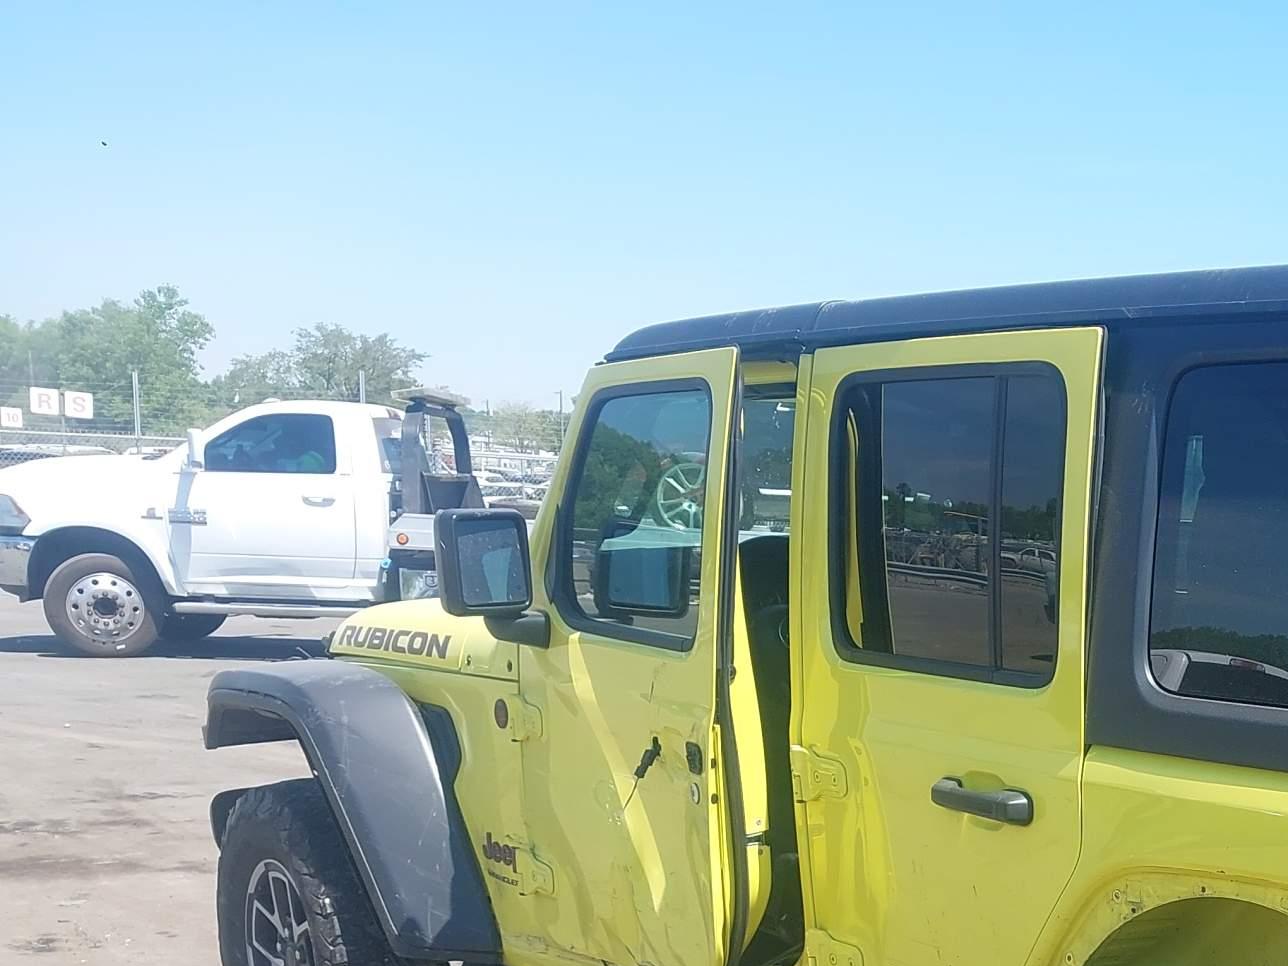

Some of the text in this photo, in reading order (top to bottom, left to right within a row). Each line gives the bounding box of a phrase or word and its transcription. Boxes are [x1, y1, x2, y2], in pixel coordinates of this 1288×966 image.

[37, 393, 53, 410] R
[72, 396, 87, 413] S
[6, 412, 19, 423] 10
[338, 625, 451, 659] RUBICON
